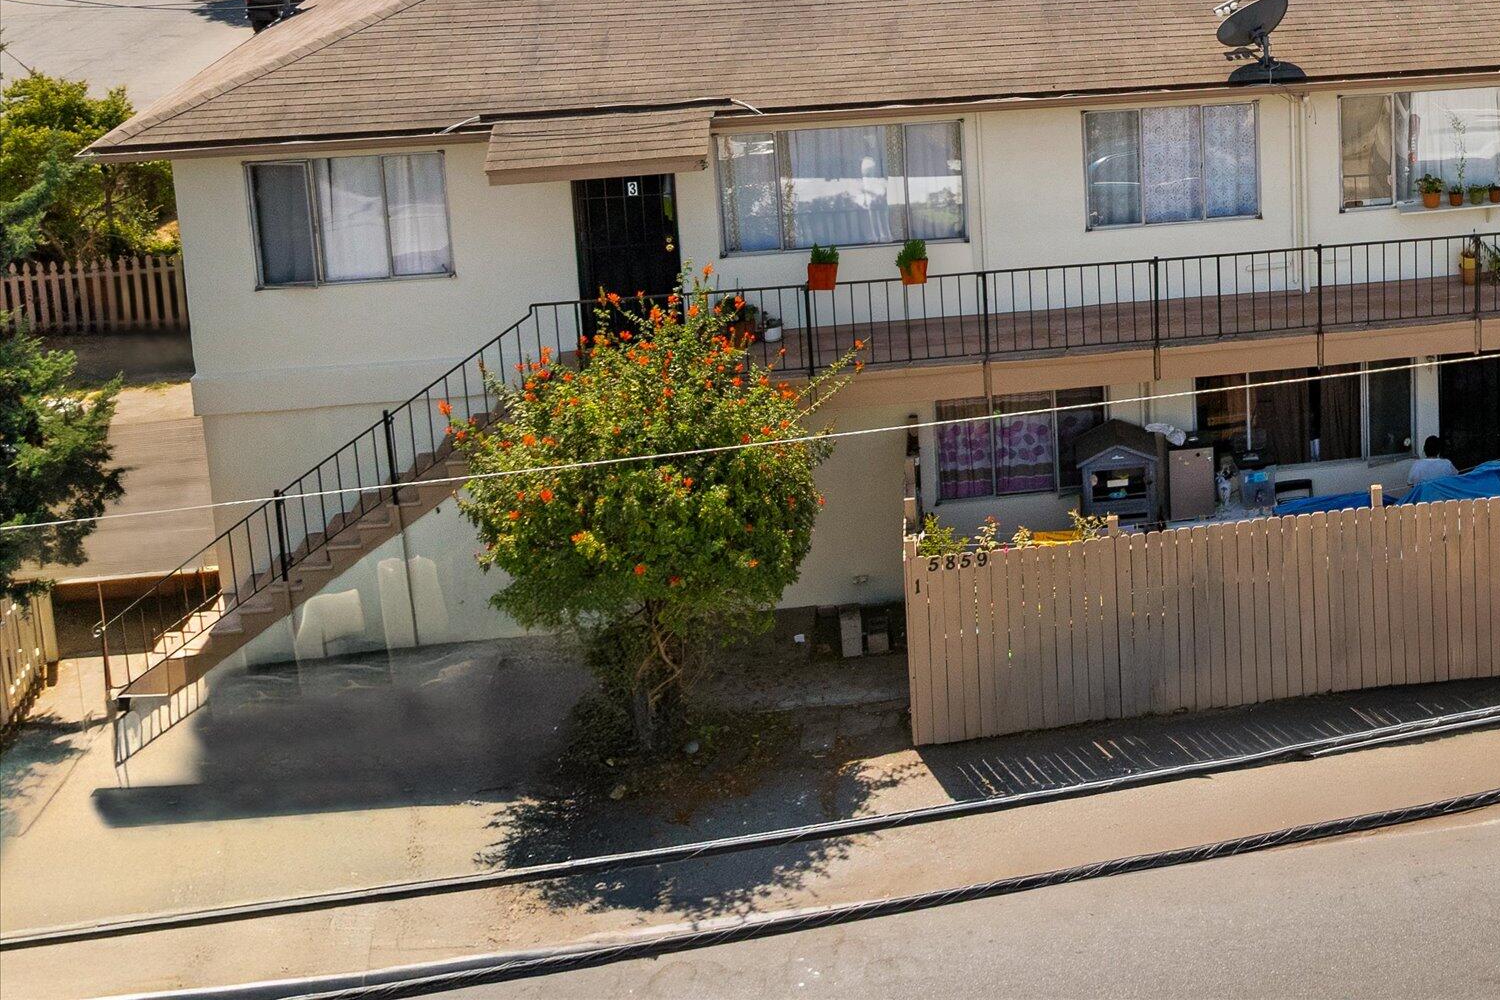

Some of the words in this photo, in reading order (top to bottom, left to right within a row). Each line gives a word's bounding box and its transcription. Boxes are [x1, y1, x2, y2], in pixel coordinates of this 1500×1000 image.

[629, 183, 637, 195] 3
[928, 552, 988, 572] 5859
[915, 578, 920, 595] 1
